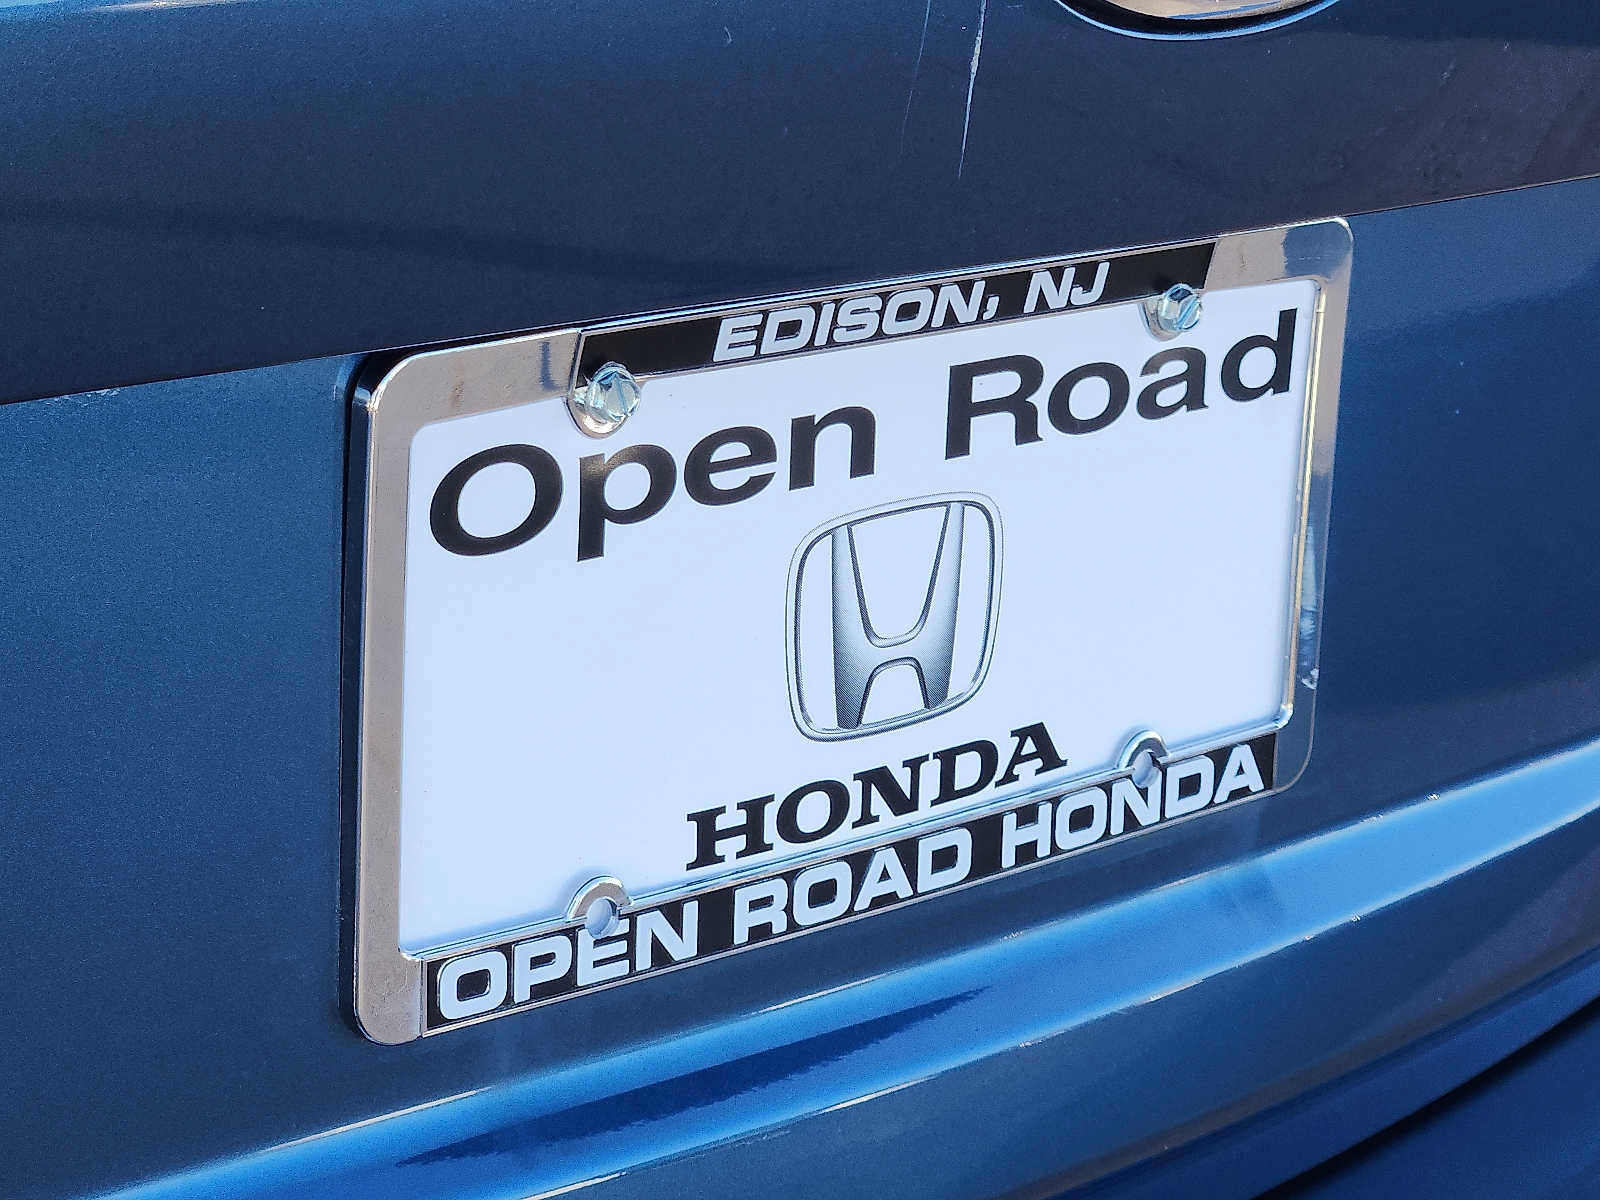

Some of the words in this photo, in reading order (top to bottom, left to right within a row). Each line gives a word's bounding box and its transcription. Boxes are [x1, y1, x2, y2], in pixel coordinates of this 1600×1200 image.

[712, 279, 999, 363] EDISON,
[1023, 261, 1111, 314] NJ
[429, 404, 876, 562] Open
[945, 308, 1298, 460] Road
[436, 900, 699, 1020] OPEN
[733, 827, 973, 946] ROAD
[1001, 743, 1265, 869] HONDA
[686, 721, 1067, 871] HONDA
